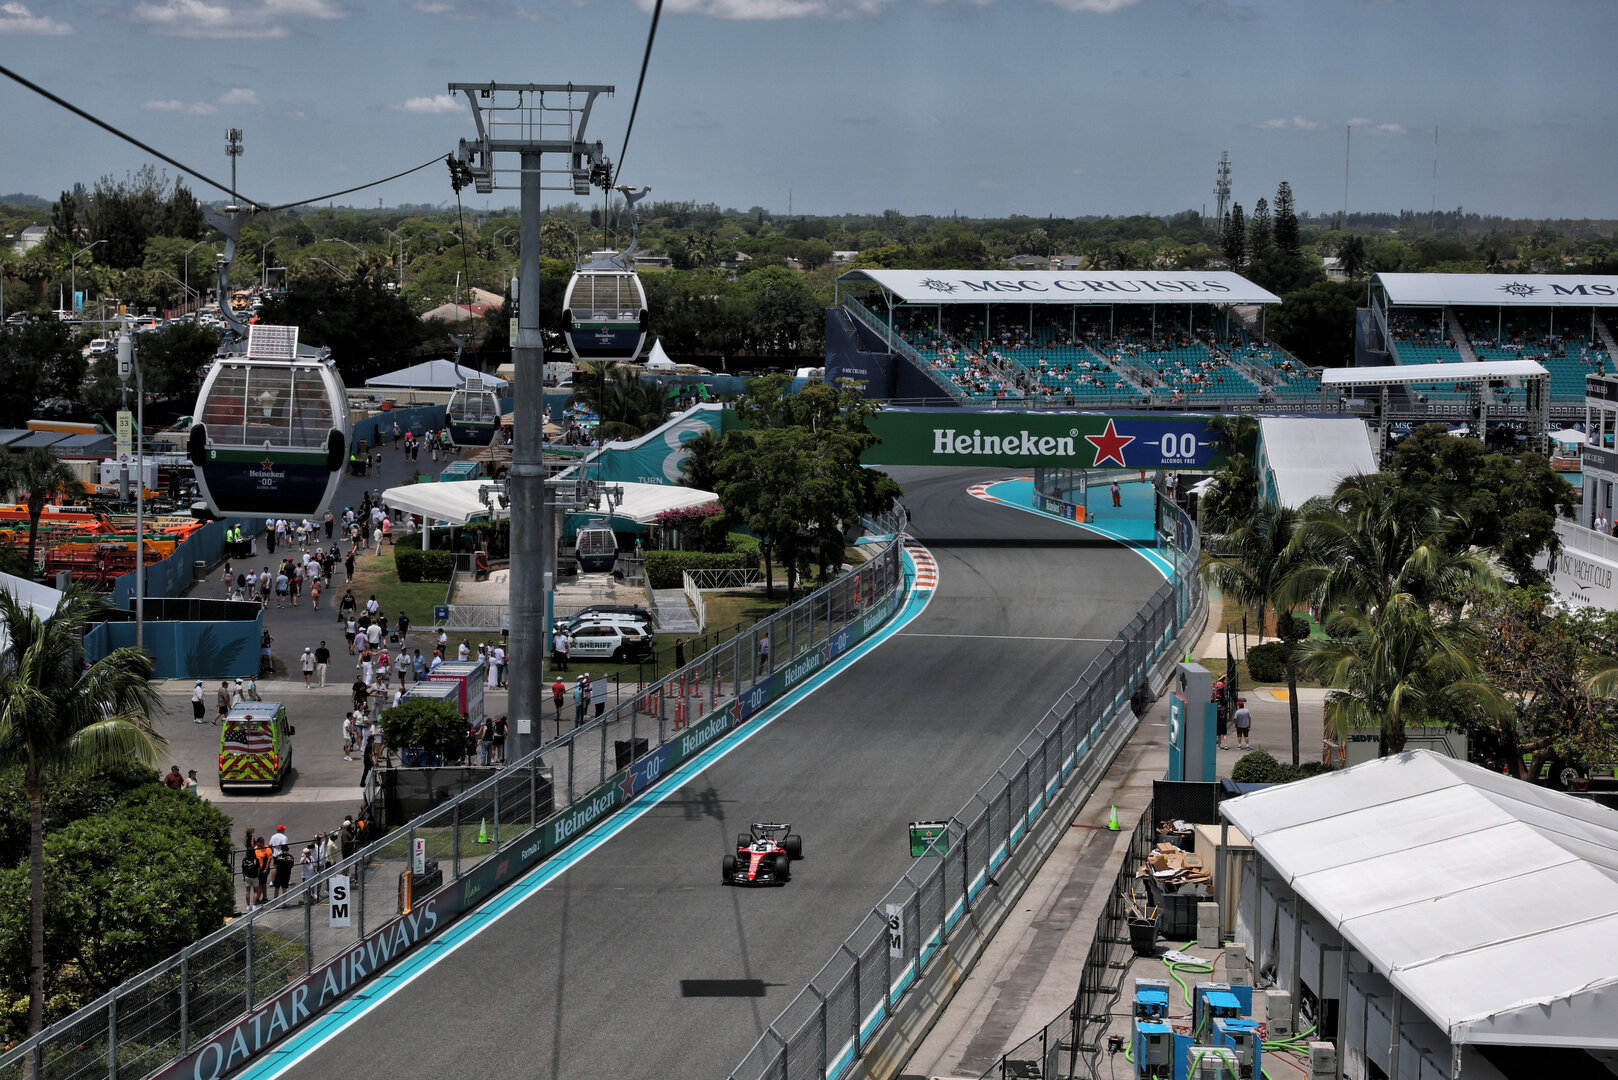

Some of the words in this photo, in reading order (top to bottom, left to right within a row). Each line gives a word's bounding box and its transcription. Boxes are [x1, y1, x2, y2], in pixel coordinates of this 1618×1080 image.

[960, 279, 1049, 292] MSC
[1053, 279, 1231, 293] CRUISES
[1546, 283, 1618, 296] MS
[210, 450, 217, 459] 9
[1161, 432, 1196, 458] 0.0
[249, 470, 285, 479] Heineken
[637, 476, 664, 484] TURN
[1574, 558, 1595, 583] YACHT
[1594, 566, 1613, 590] CLUB
[784, 652, 821, 687] Heineken
[681, 714, 728, 757] Heineken
[1170, 705, 1180, 744] 5
[646, 755, 660, 780] 0.0
[554, 788, 616, 845] Heineken
[193, 984, 311, 1080] QATAR
[318, 898, 438, 1007] AIRWAYS
